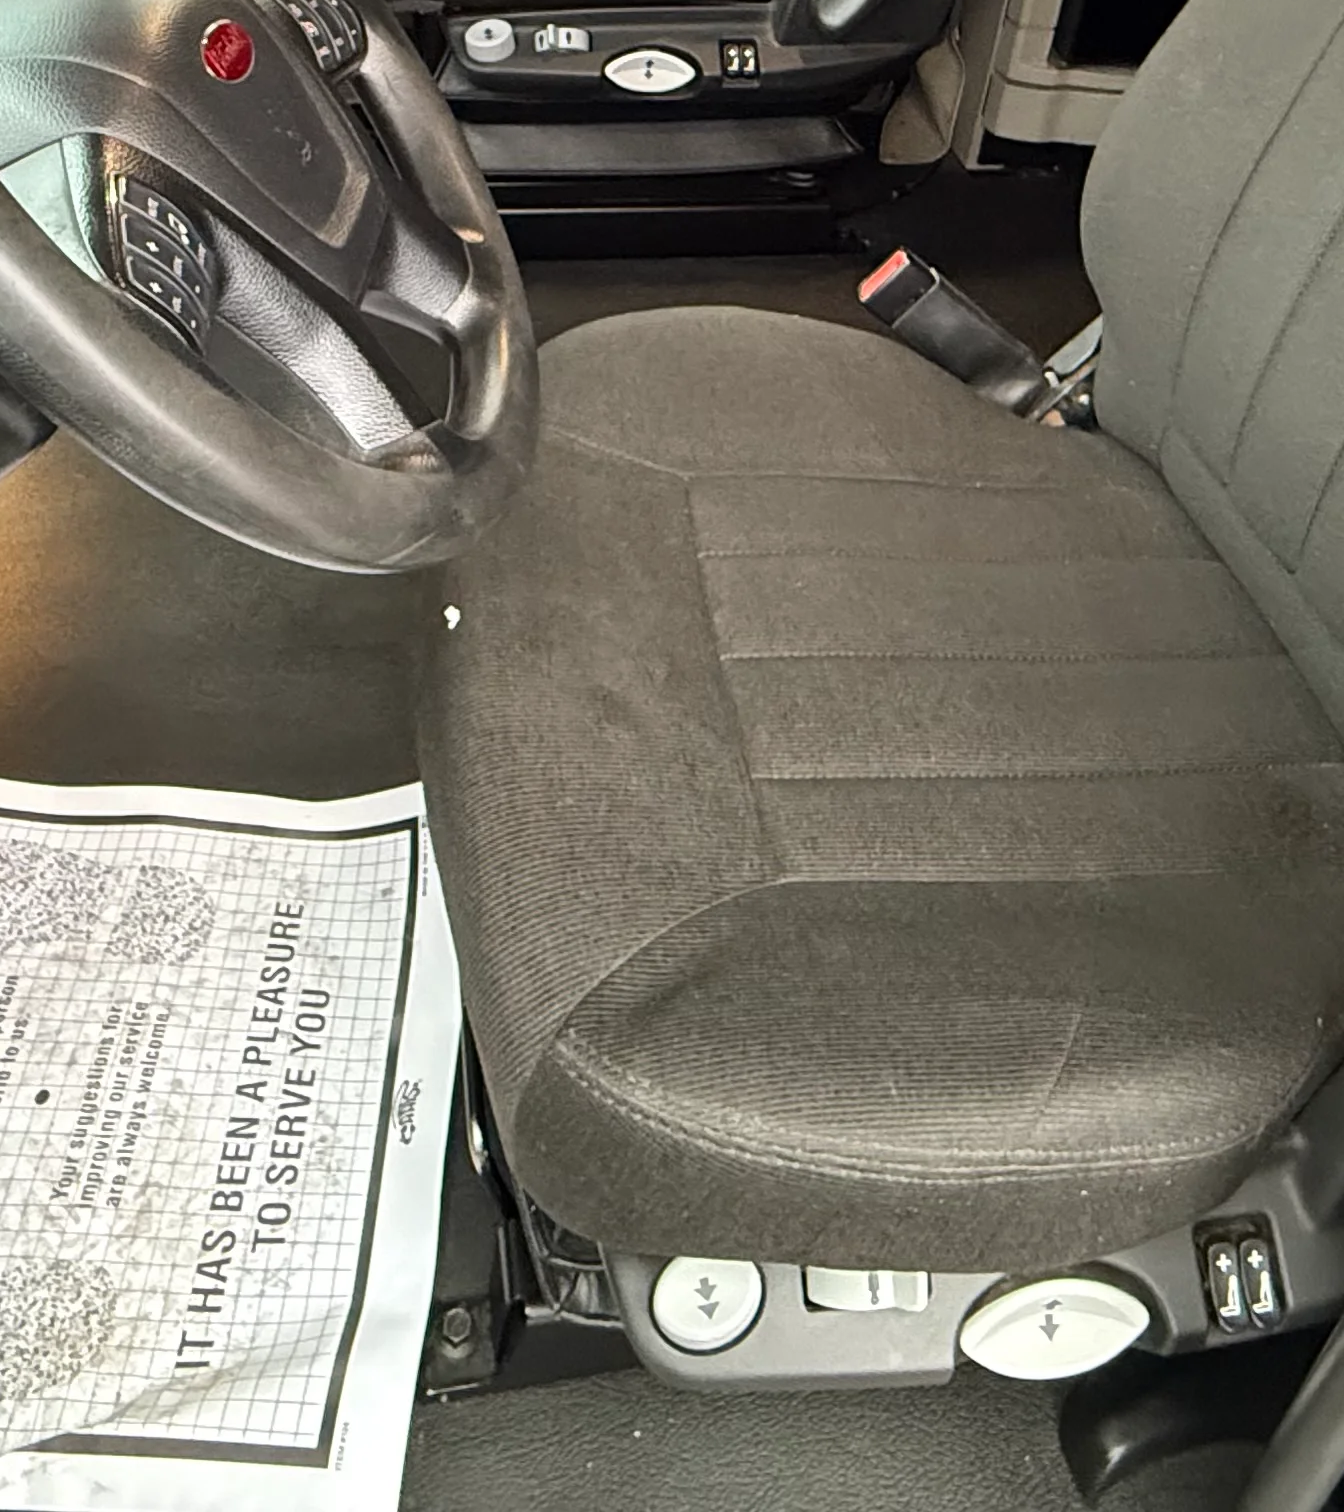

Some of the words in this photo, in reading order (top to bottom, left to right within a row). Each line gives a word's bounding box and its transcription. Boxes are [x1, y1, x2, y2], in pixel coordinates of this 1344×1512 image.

[242, 899, 305, 1067] PLEASURE
[0, 1045, 20, 1063] to
[119, 1001, 150, 1067] service
[292, 989, 332, 1057] YOU
[49, 1155, 80, 1201] Your
[69, 1037, 115, 1150] suggestions
[102, 1005, 124, 1031] for
[109, 1071, 130, 1103] our
[234, 1080, 269, 1103] A
[116, 1100, 148, 1169] always
[266, 1067, 316, 1186] SERVE
[105, 1174, 128, 1208] are
[209, 1114, 260, 1213] BEEN
[250, 1203, 293, 1254] TO
[186, 1228, 237, 1313] HAS
[175, 1329, 216, 1369] IT
